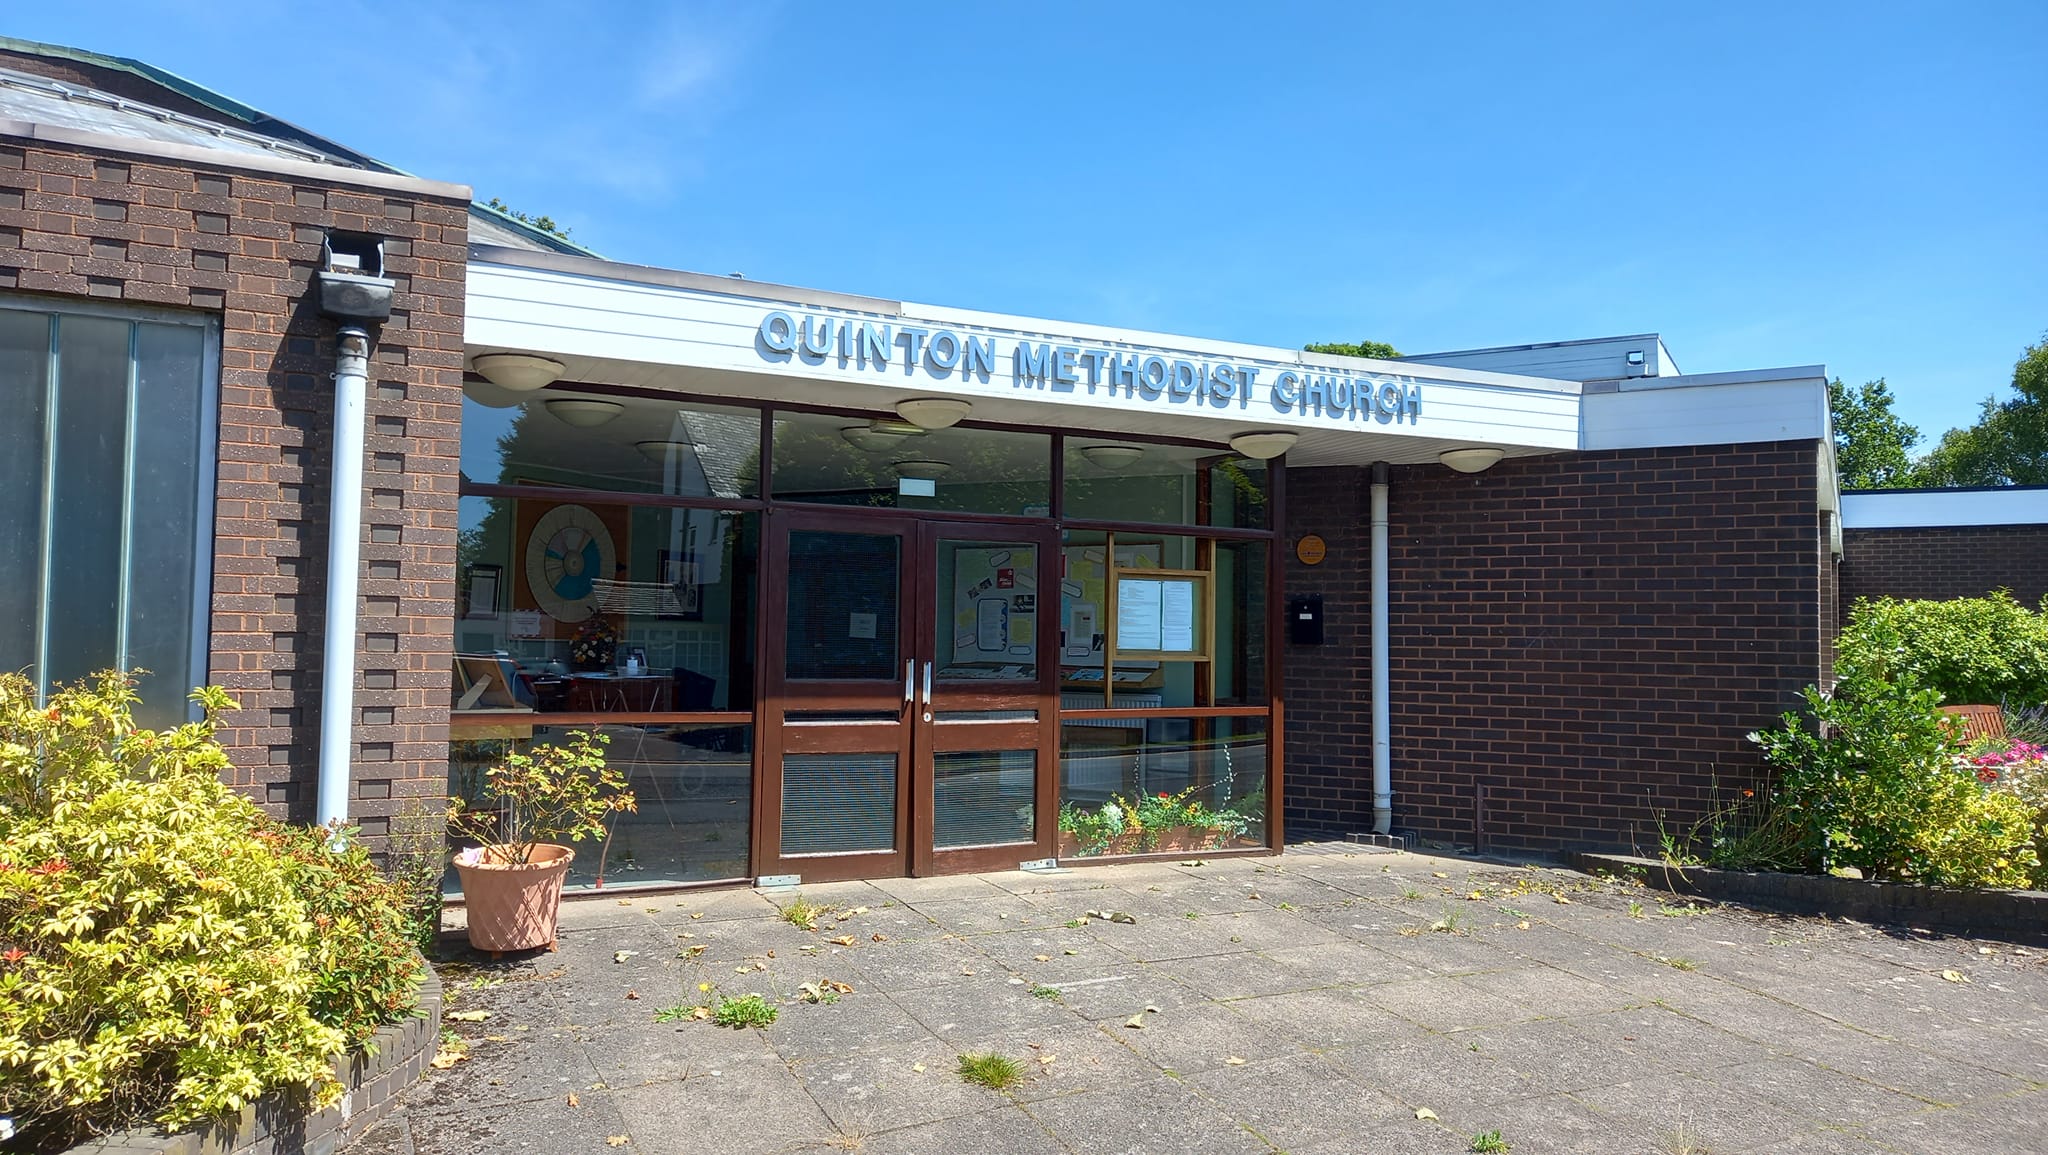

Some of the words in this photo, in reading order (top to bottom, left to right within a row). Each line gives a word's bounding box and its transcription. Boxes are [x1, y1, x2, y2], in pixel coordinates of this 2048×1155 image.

[760, 311, 996, 374] QUINTON
[1018, 341, 1260, 400] METHODIST
[1276, 370, 1422, 417] CHURCH
